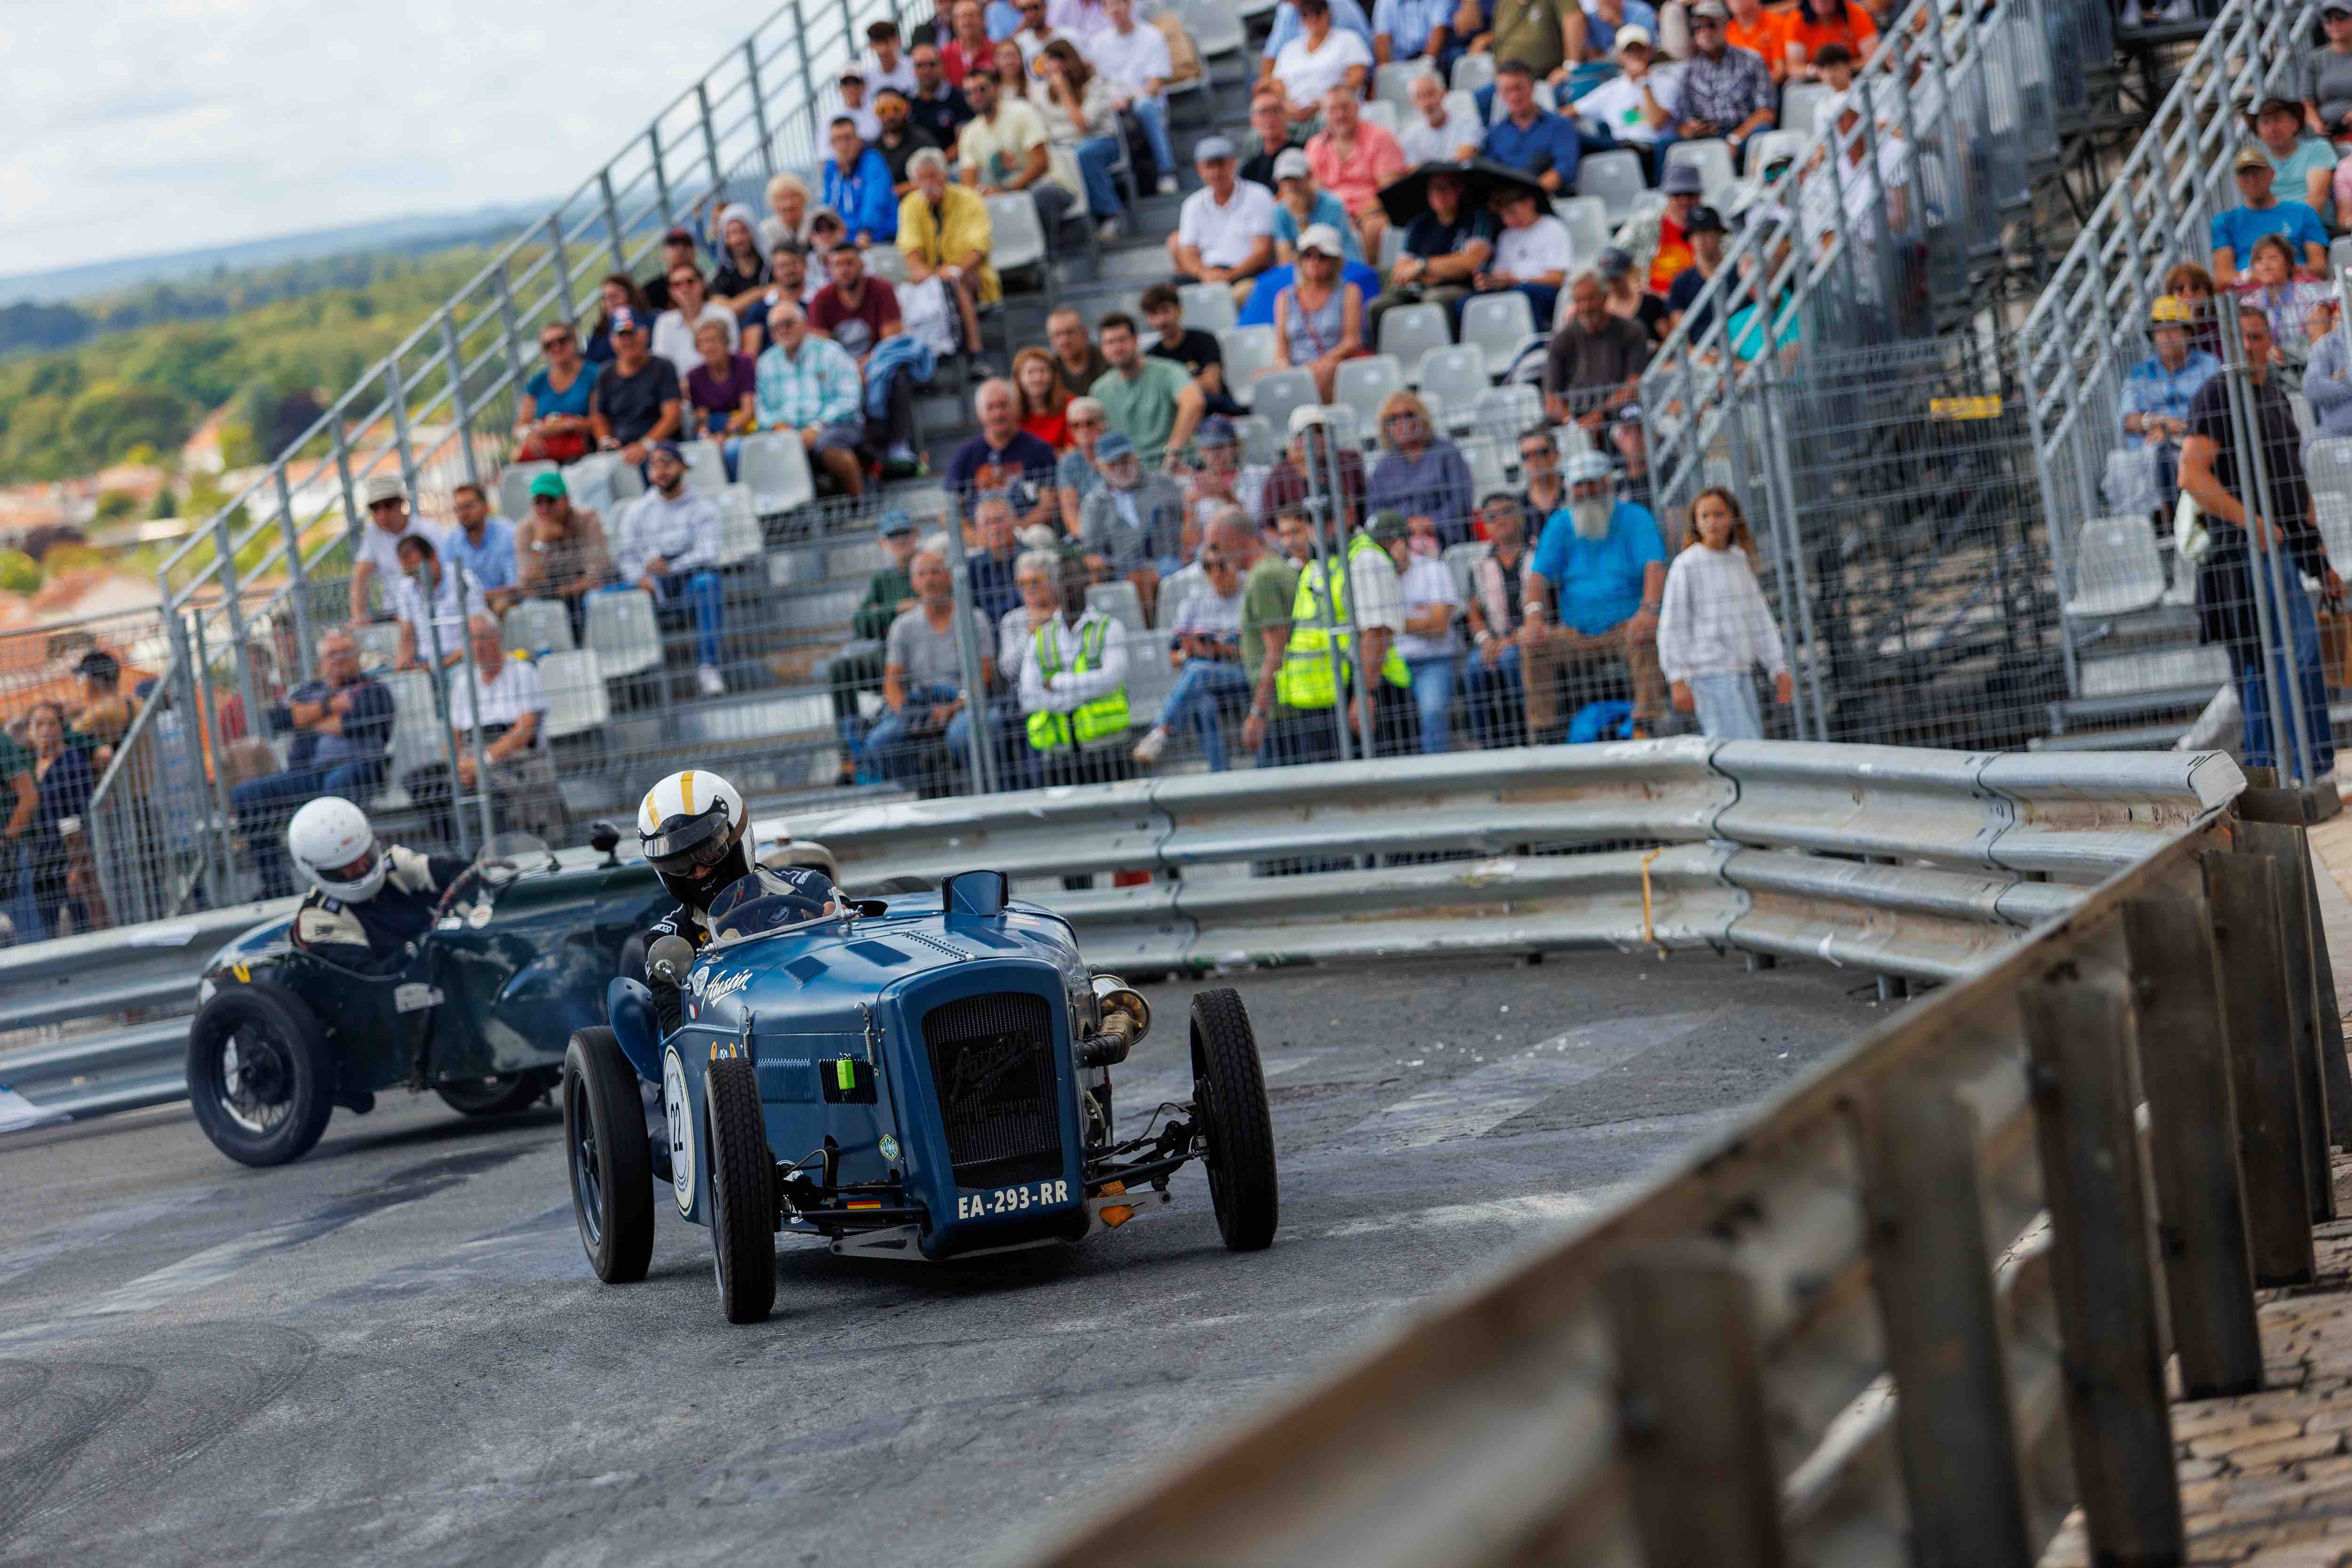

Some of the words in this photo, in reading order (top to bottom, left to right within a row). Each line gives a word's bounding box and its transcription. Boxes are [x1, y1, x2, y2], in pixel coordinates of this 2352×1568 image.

[701, 969, 753, 1015] Austin
[671, 1101, 683, 1152] 22
[958, 1180, 1068, 1219] EA-293-RR
